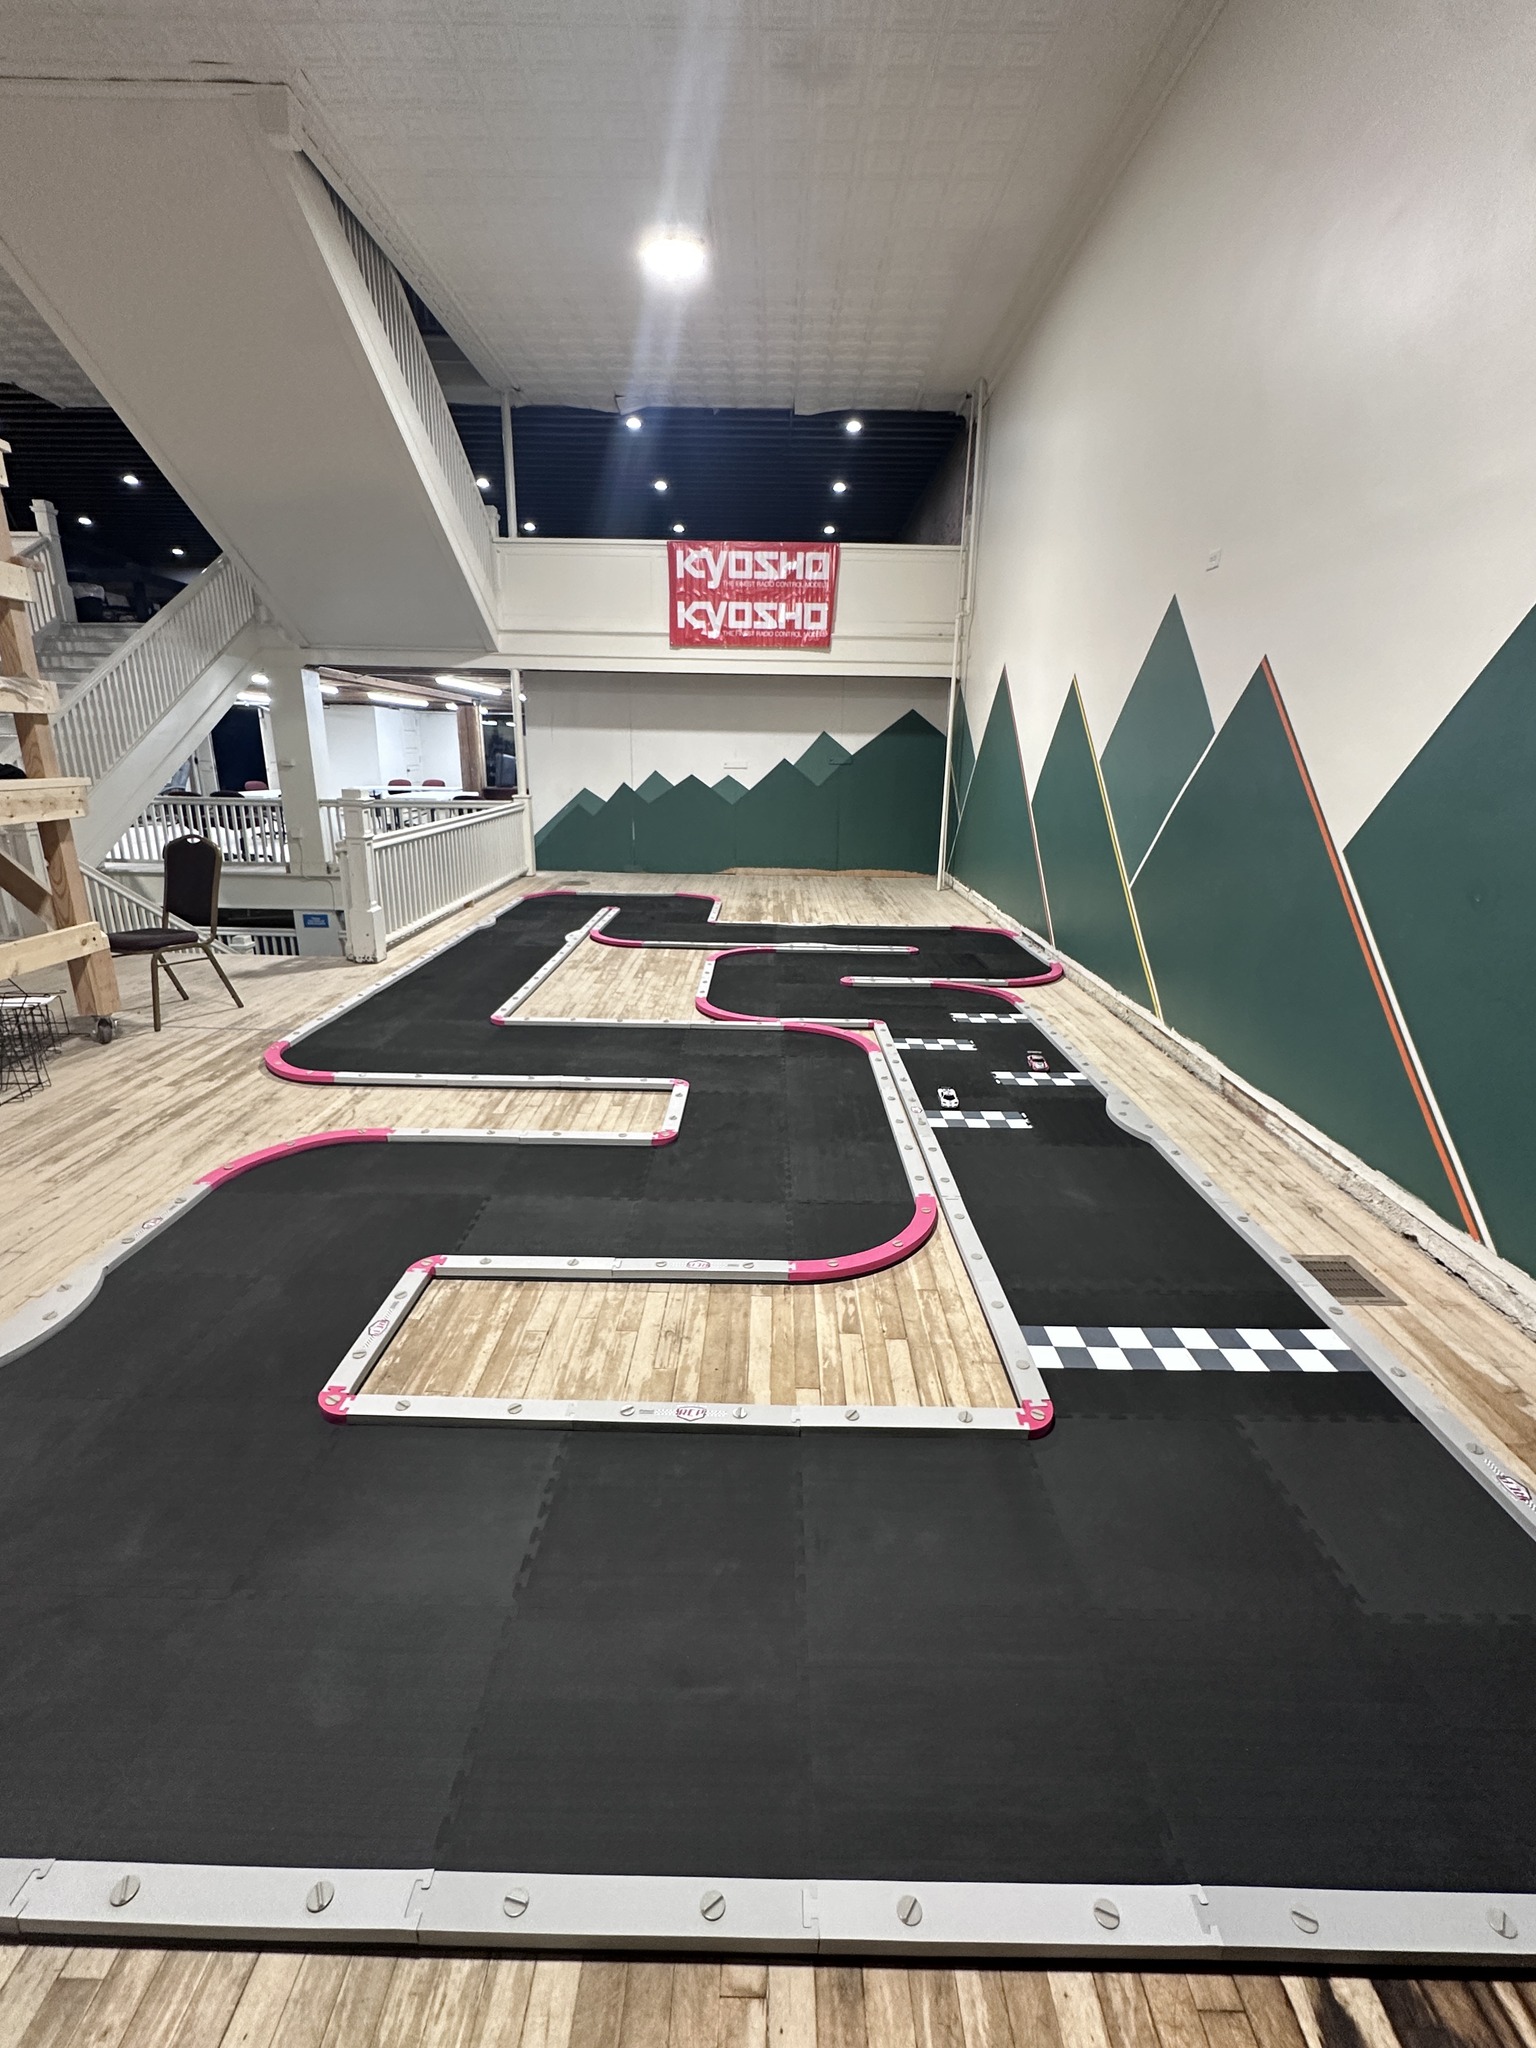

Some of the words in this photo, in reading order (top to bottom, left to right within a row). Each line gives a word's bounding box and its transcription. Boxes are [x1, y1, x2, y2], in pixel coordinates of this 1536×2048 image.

[676, 548, 830, 589] KYOSHO
[756, 580, 774, 588] RADIO
[676, 601, 829, 639] KYOSHO
